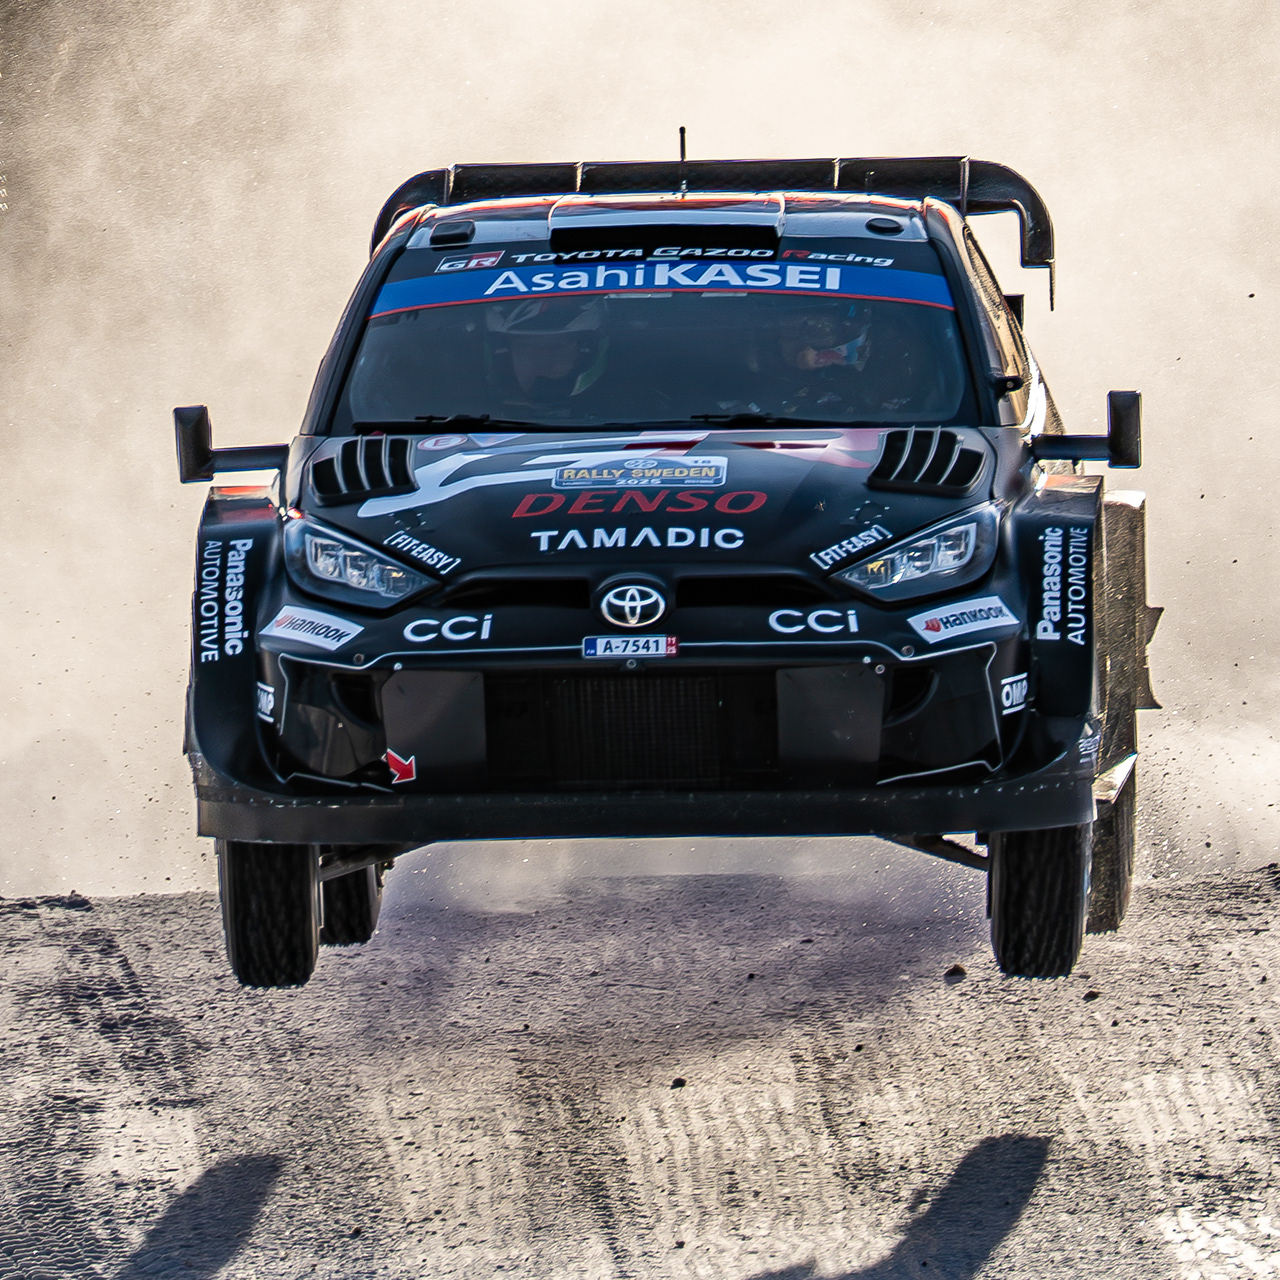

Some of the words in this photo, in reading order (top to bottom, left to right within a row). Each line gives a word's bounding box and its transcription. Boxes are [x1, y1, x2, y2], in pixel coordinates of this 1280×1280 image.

[438, 253, 500, 271] GR
[509, 247, 644, 264] TOYOTA
[652, 246, 775, 259] GAZOO
[781, 248, 896, 268] Racing
[562, 468, 624, 480] RALLY
[630, 466, 716, 479] SWEDEN
[615, 478, 662, 486] 2025
[511, 489, 769, 519] DENSO
[530, 527, 745, 552] TAMADIC
[224, 538, 254, 657] Panasonic
[1036, 526, 1064, 641] Panasonic
[1066, 526, 1090, 646] AUTOMOTIVE
[200, 540, 222, 663] AUTOMOTIVE
[603, 639, 660, 654] A-7541
[1001, 678, 1028, 709] OMP
